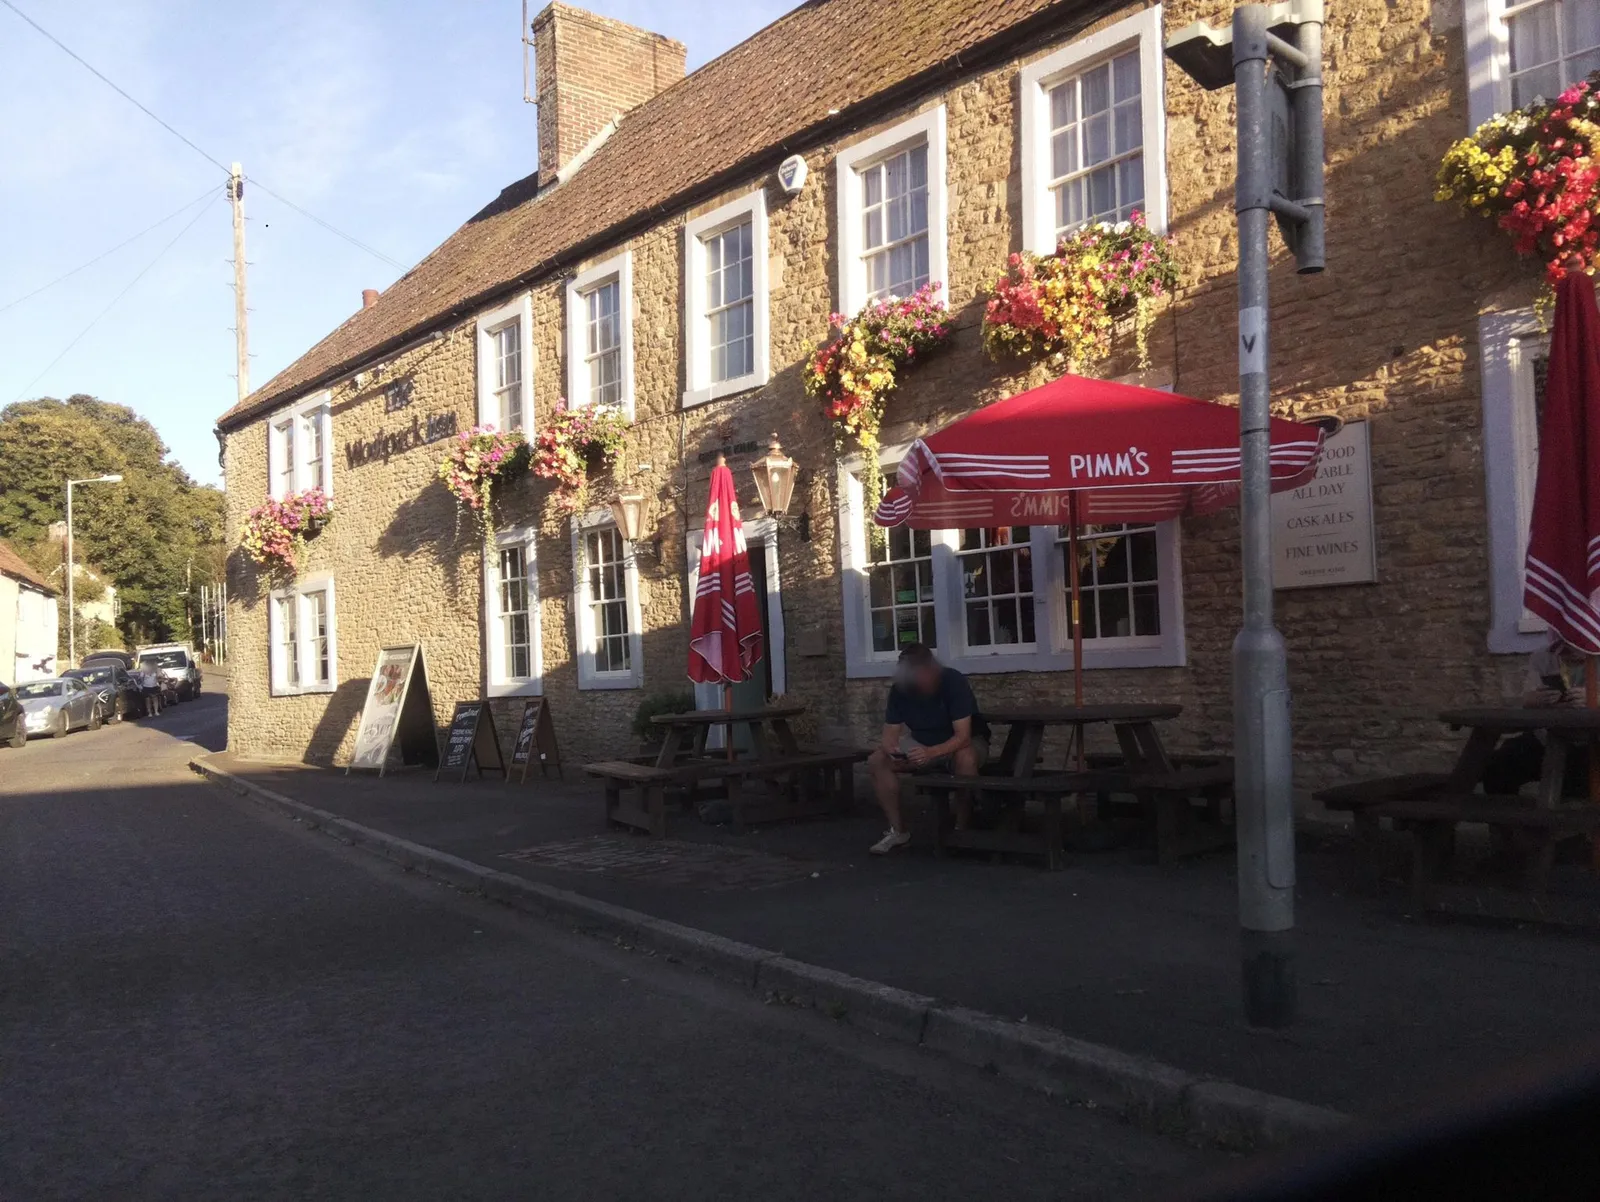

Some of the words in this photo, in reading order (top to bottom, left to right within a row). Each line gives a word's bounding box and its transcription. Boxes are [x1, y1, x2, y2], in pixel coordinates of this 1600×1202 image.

[1070, 446, 1150, 478] PIMM'S
[1292, 486, 1316, 500] ALL
[1319, 482, 1345, 497] DAY
[1287, 515, 1320, 529] CASK
[1322, 511, 1354, 525] ALES
[1285, 545, 1315, 559] FINE
[1316, 540, 1359, 556] WINES
